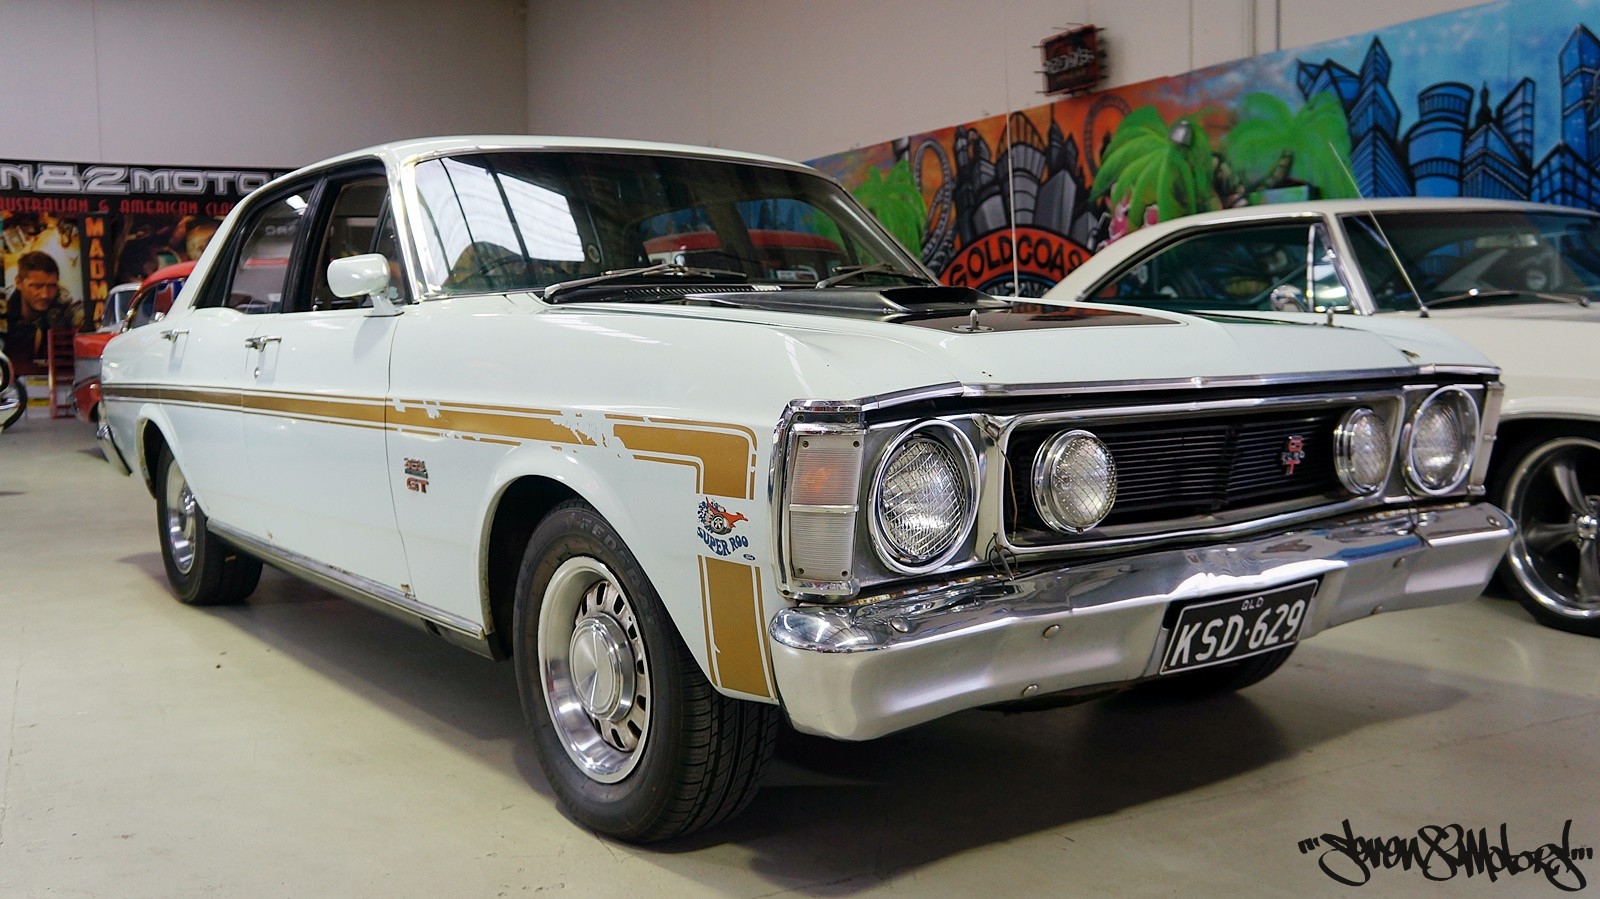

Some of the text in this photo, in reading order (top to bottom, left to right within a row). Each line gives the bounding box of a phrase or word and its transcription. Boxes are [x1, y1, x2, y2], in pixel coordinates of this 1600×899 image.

[120, 200, 198, 215] AMERICAN
[697, 527, 749, 556] SUPER ROO
[1241, 596, 1264, 611] QLD
